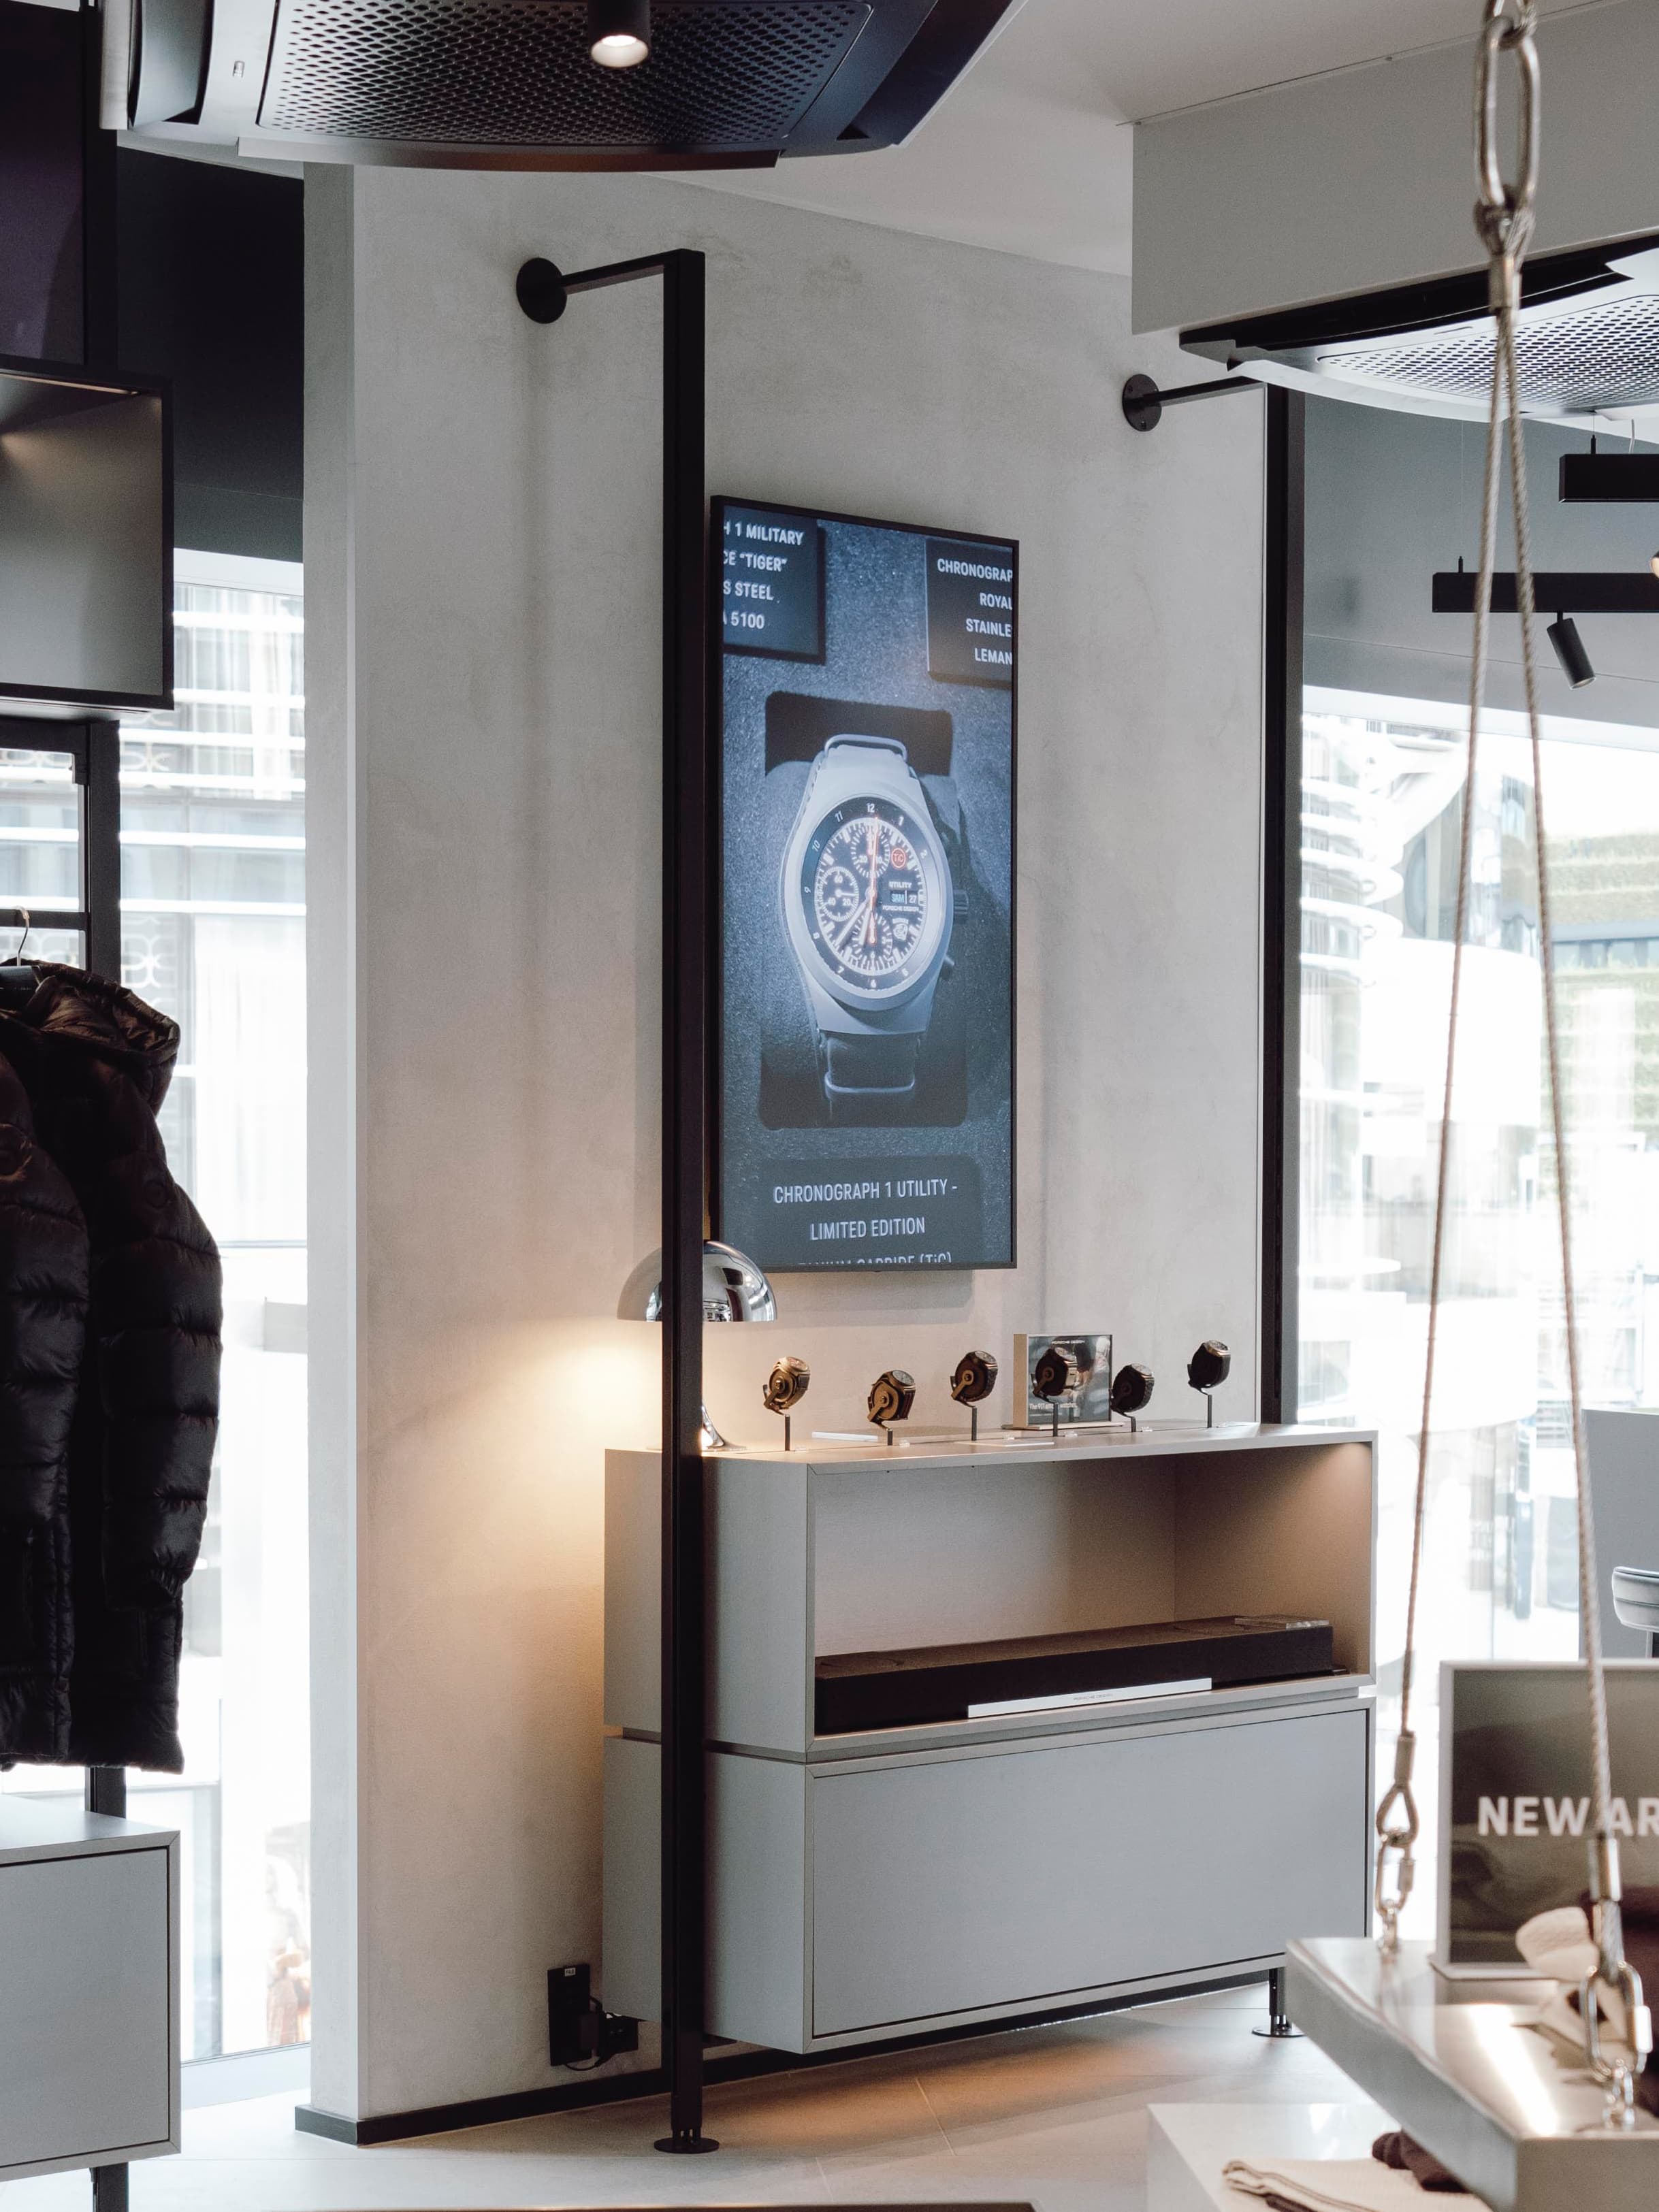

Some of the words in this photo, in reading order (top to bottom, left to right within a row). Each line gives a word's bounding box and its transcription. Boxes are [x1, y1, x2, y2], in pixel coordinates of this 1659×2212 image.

[735, 522, 742, 537] 1
[746, 523, 805, 546] MILITARY
[937, 558, 1013, 582] CHRONOGRAP
[735, 582, 774, 601] STEEL
[980, 592, 1013, 611] ROYAL
[731, 611, 765, 630] 5100
[965, 618, 1012, 638] STAINLE
[974, 647, 1013, 665] LEMAN
[866, 802, 875, 813] 12
[811, 840, 821, 851] 10
[773, 1182, 880, 1204] CHRONOGRAPH
[884, 1182, 892, 1198] 1
[897, 1178, 948, 1198] UTILITY
[810, 1220, 867, 1241] LIMITED
[871, 1216, 926, 1237] EDITION
[1478, 1796, 1591, 1837] NEW
